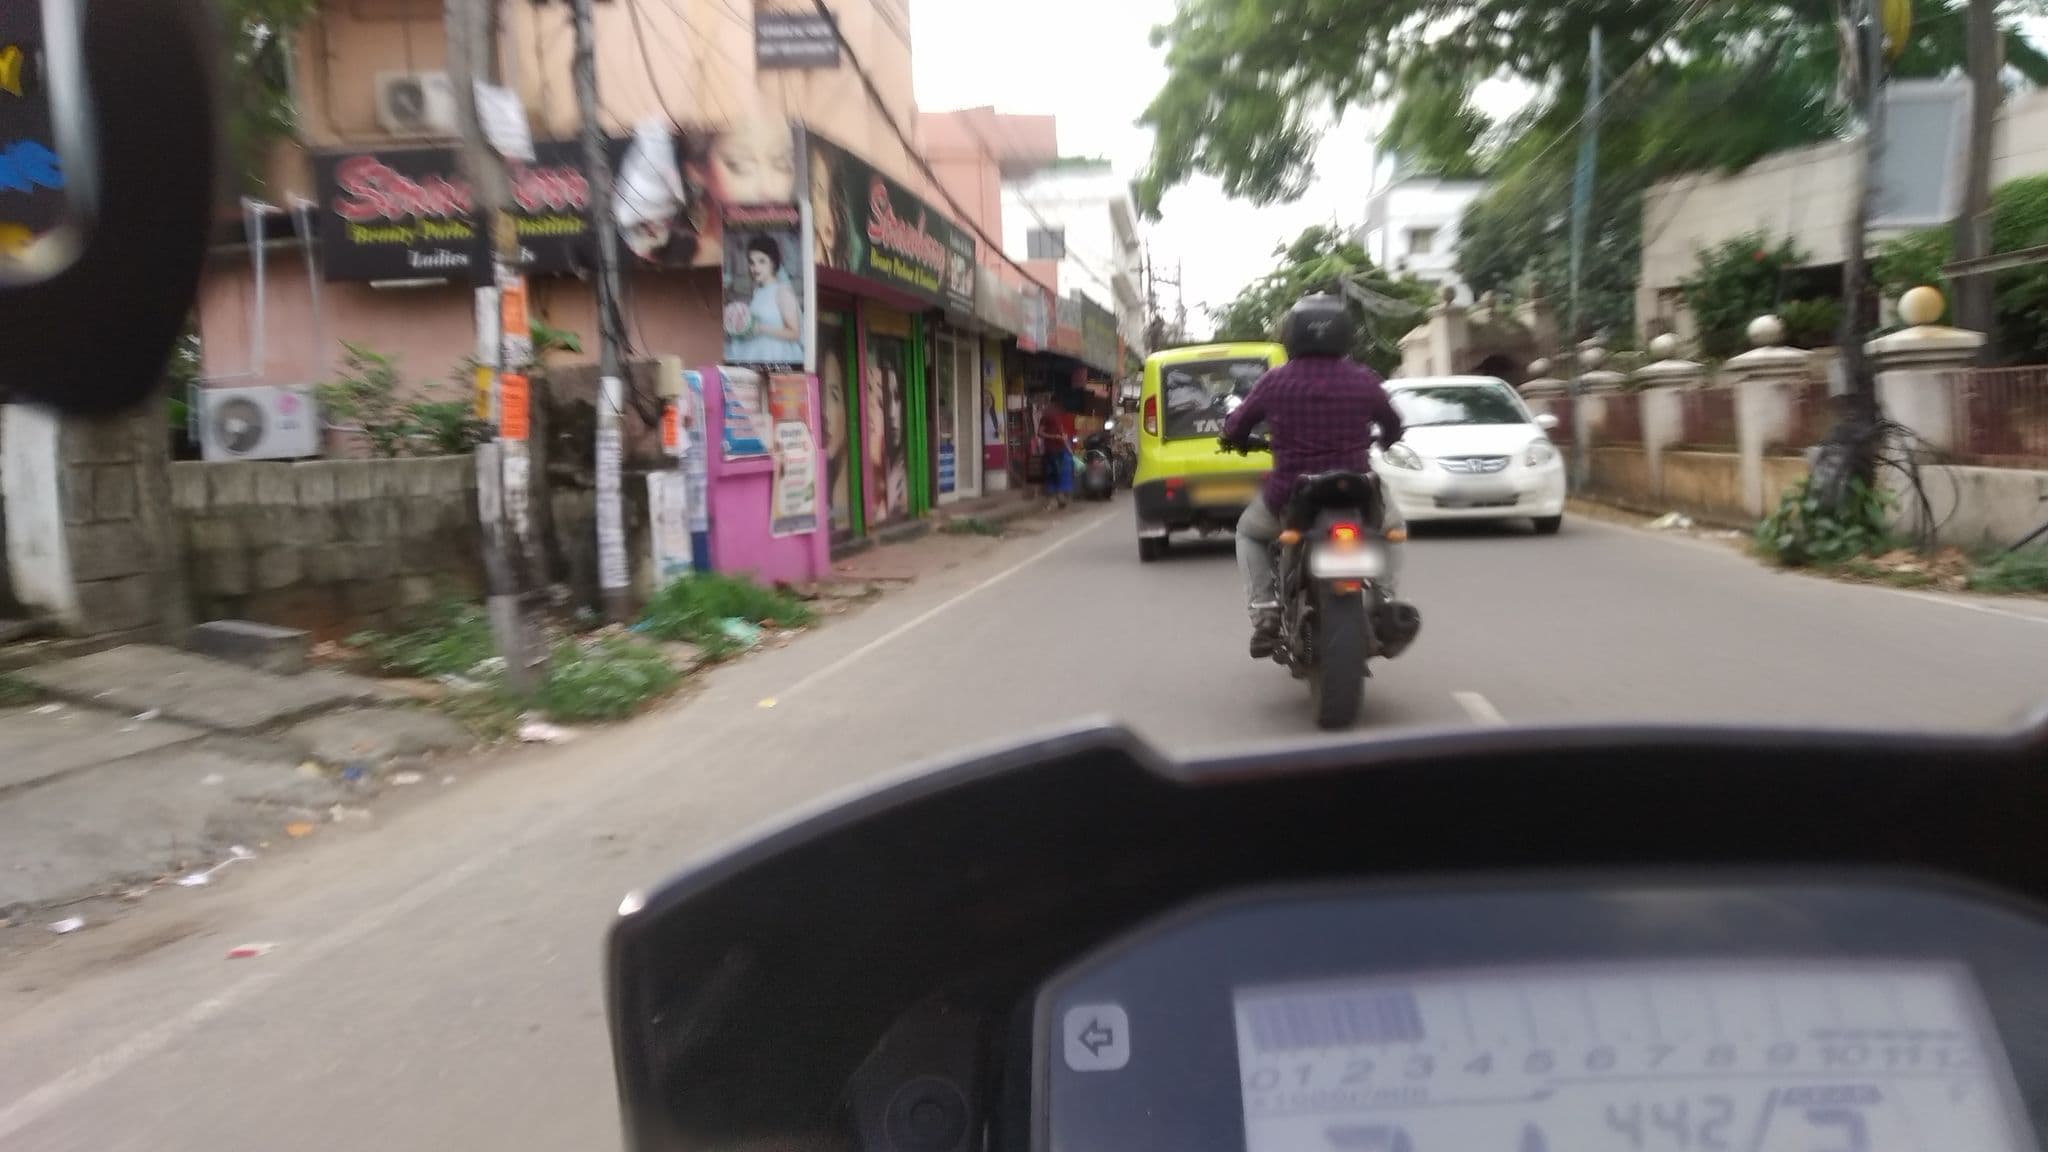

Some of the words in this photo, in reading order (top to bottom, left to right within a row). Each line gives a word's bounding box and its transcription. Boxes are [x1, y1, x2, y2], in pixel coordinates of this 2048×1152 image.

[1193, 418, 1226, 433] TAT
[1339, 1057, 1376, 1085] 2
[1460, 1050, 1494, 1076] 4
[1648, 1044, 1682, 1070] 7
